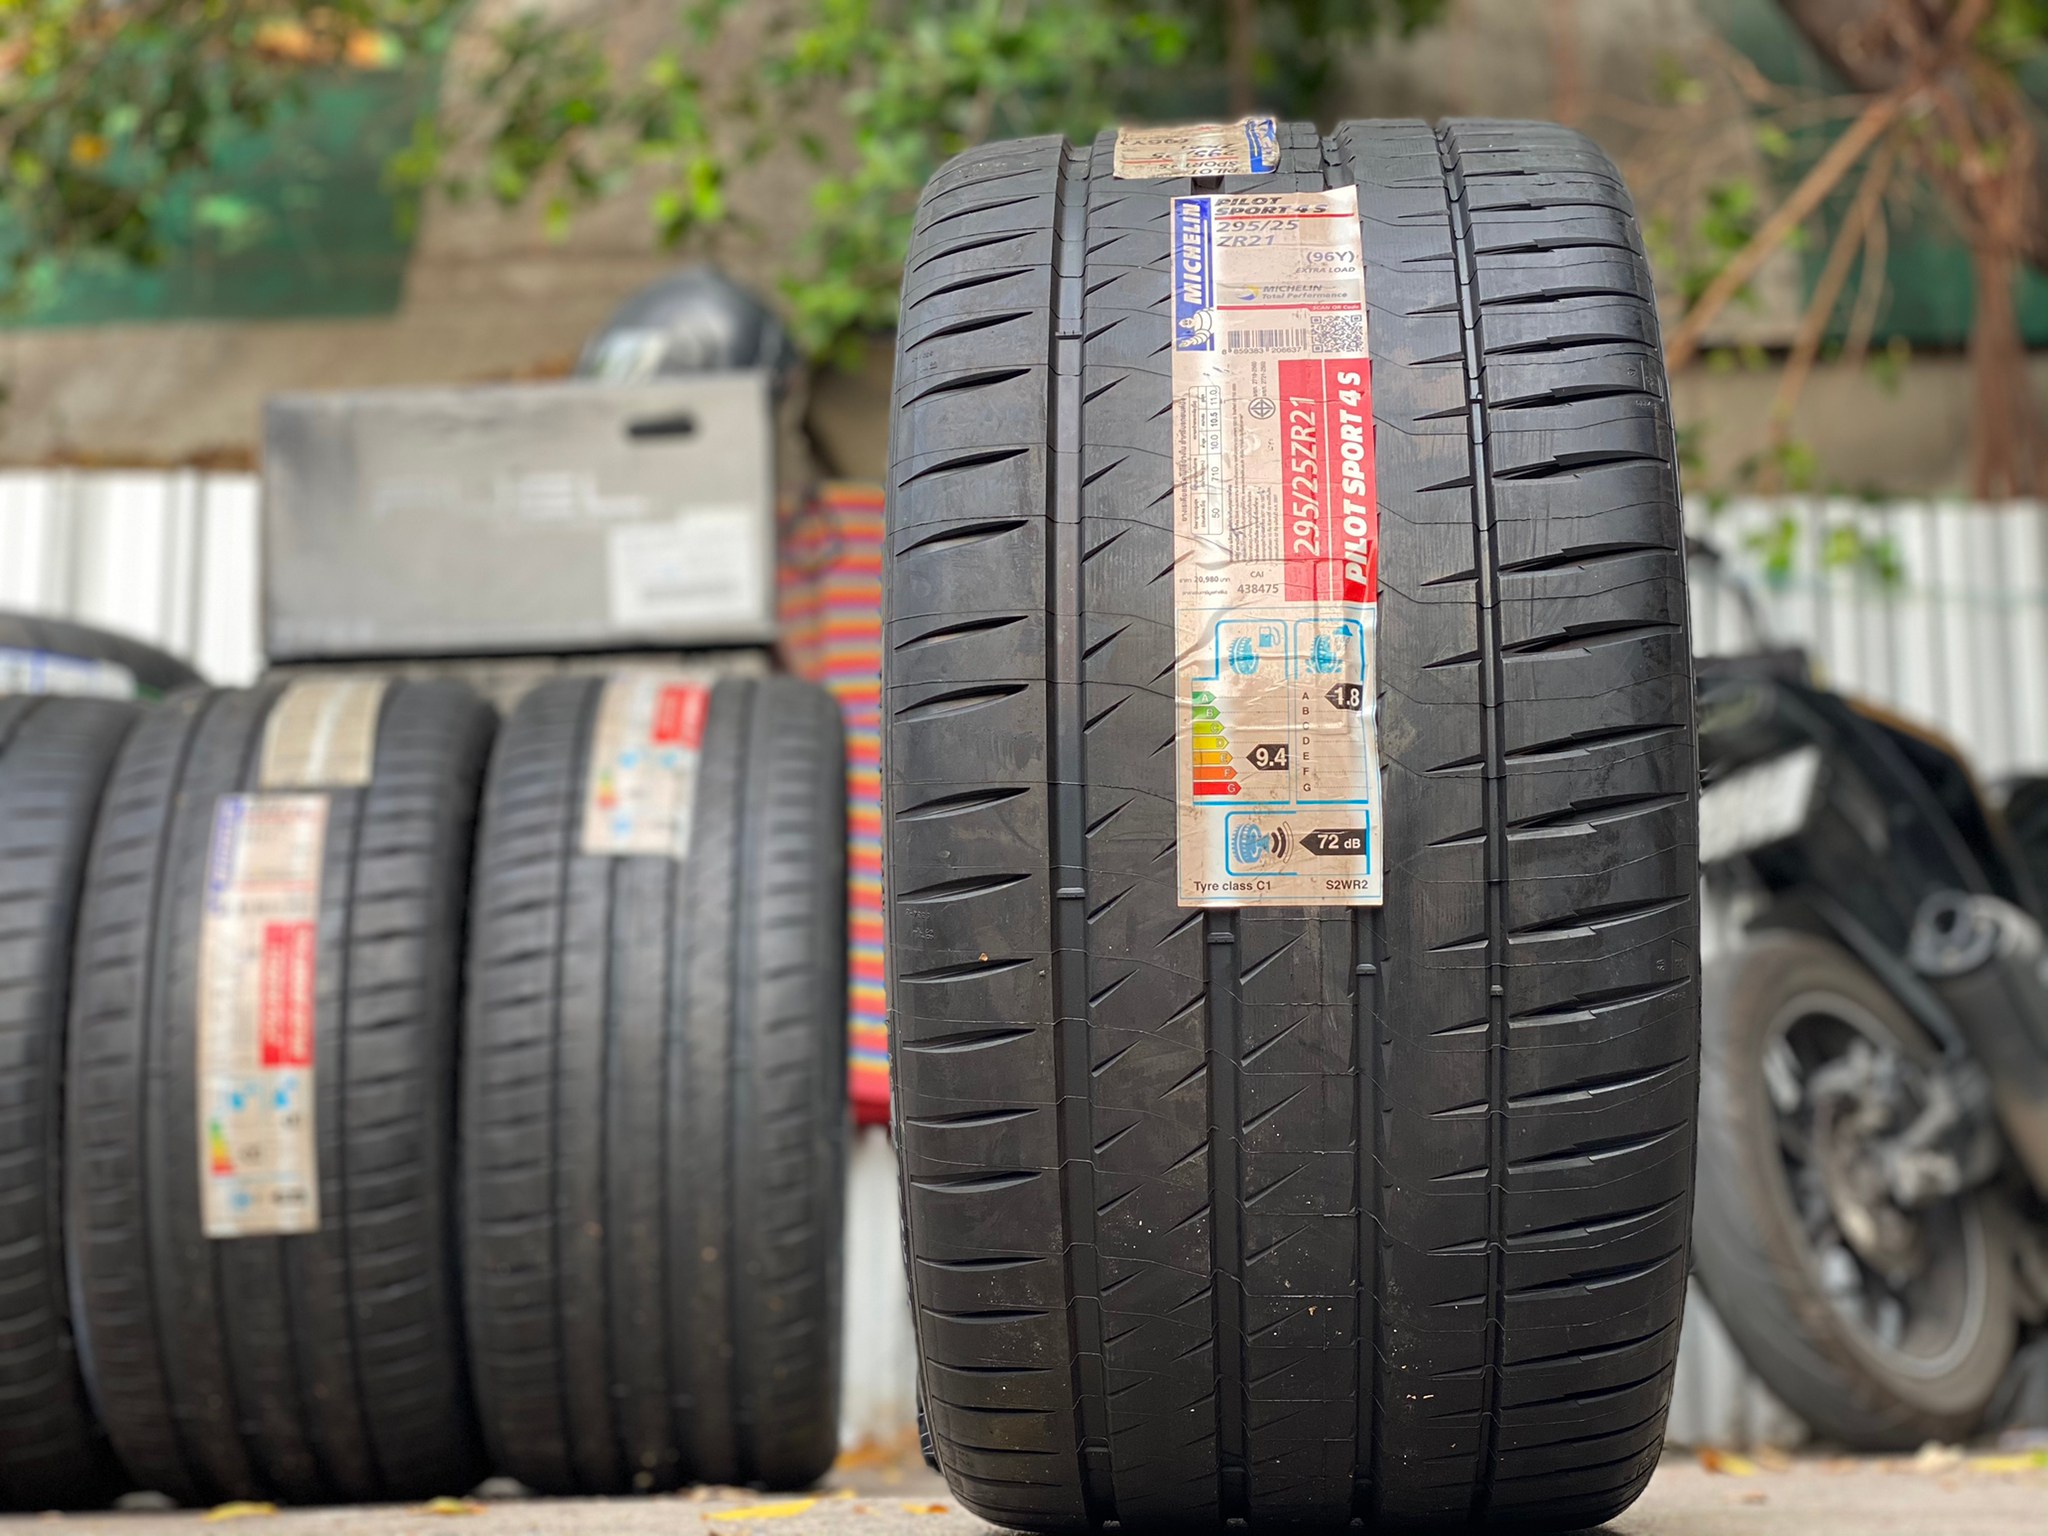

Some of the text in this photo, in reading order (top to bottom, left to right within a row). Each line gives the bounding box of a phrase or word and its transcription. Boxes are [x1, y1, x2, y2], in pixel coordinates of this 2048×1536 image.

[1215, 196, 1282, 206] PILOT
[1215, 205, 1289, 215] SPORT
[1313, 204, 1329, 213] S
[1216, 219, 1299, 232] 295/25
[1216, 235, 1275, 247] ZR21
[1183, 203, 1202, 304] MICHELIN
[1306, 250, 1355, 263] (96Y)
[1263, 284, 1323, 292] MICHELIN
[1287, 291, 1348, 299] Performance
[1209, 389, 1217, 405] 11.0
[1210, 412, 1218, 427] 10.5
[1210, 434, 1218, 450] 10.0
[1211, 466, 1219, 482] 710
[1289, 396, 1320, 556] 295/25ZR21
[1337, 371, 1367, 585] PILOT SPORT 4 S
[1212, 508, 1220, 518] 50
[1237, 584, 1279, 594] 438475
[1201, 694, 1208, 703] A
[1302, 692, 1309, 700] A
[1336, 688, 1360, 707] 1.8
[1206, 709, 1213, 717] B
[1303, 707, 1309, 715] B
[1210, 724, 1219, 732] C
[1303, 737, 1310, 745] D
[1220, 754, 1227, 762] E
[1256, 747, 1287, 766] 9.4
[1303, 752, 1309, 760] E
[1224, 768, 1231, 777] F
[1303, 768, 1309, 776] F
[1227, 784, 1236, 793] G
[1303, 783, 1311, 792] G
[1317, 835, 1361, 849] 72 dB
[1194, 880, 1271, 892] Tyre class C1
[1326, 880, 1369, 890] S2WR2
